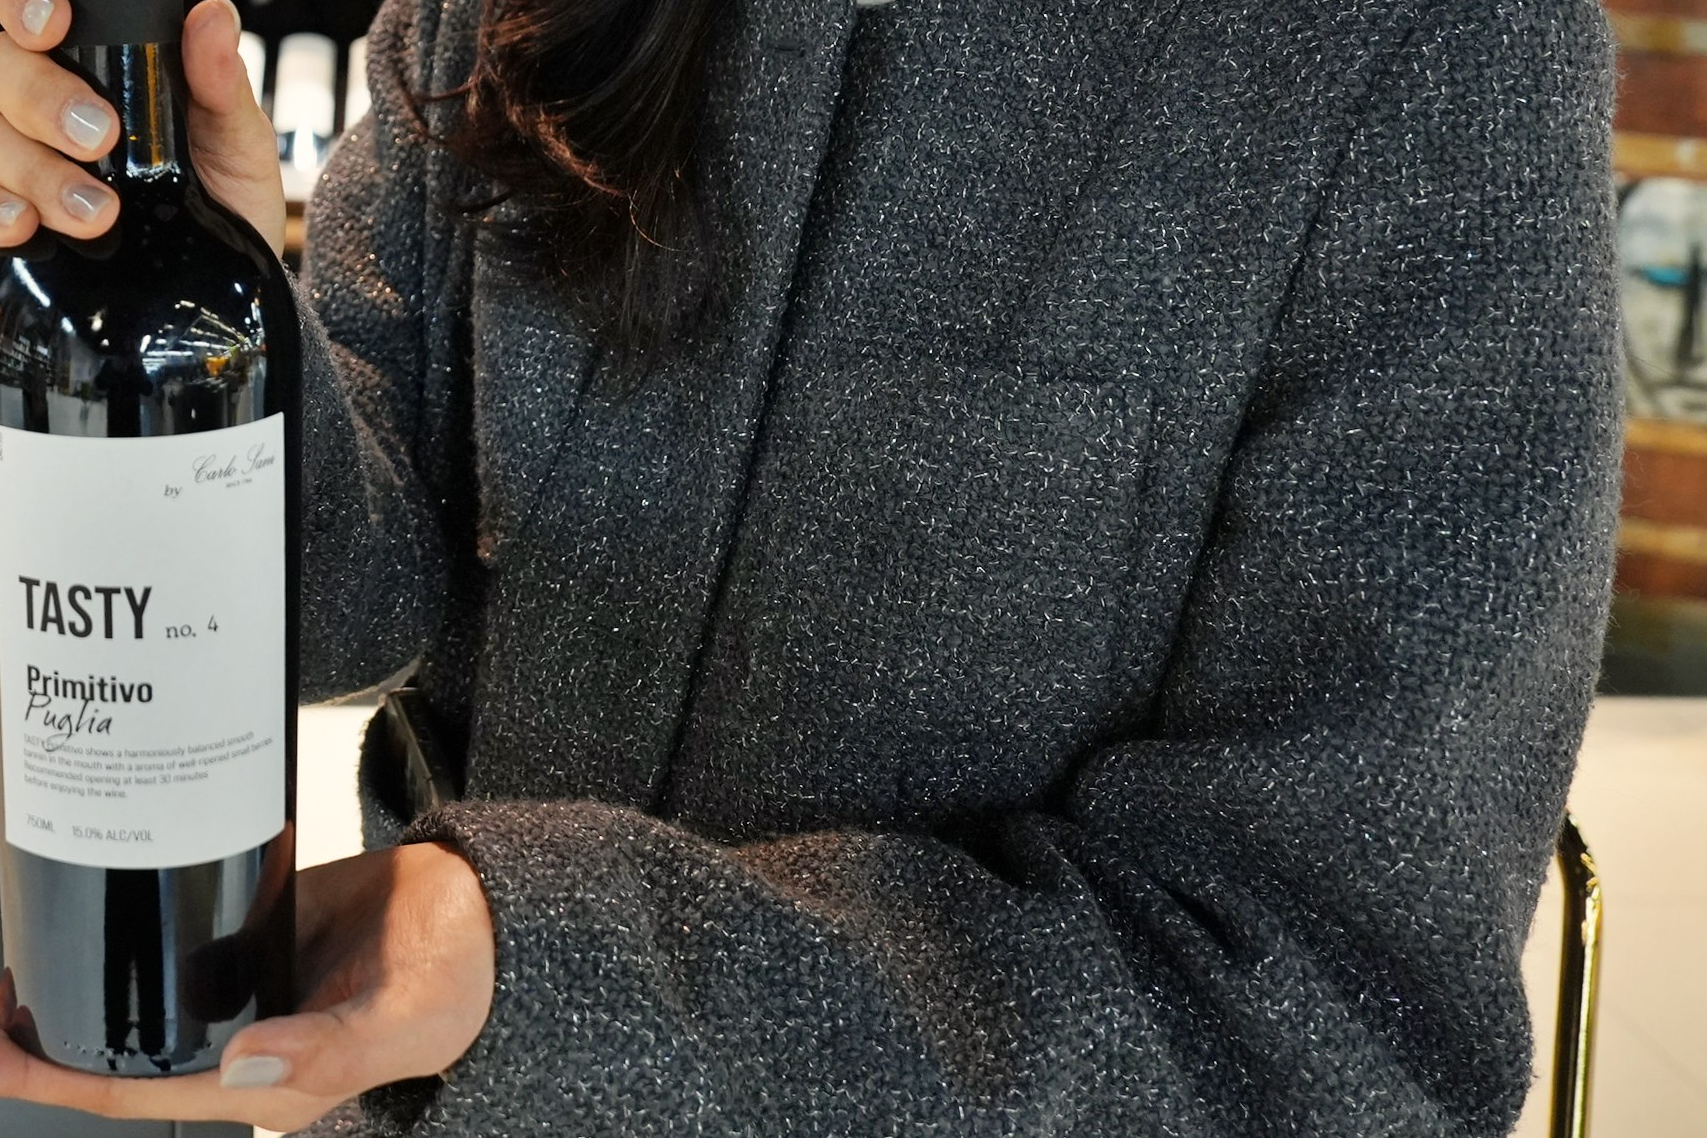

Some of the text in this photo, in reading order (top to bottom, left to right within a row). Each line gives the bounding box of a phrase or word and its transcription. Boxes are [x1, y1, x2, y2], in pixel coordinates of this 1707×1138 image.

[164, 484, 182, 499] by
[18, 575, 219, 639] TASTY no. 4
[27, 663, 153, 704] Primitivo
[24, 689, 113, 752] Puglia
[86, 747, 114, 758] shows
[73, 758, 103, 770] mouth
[105, 760, 125, 771] with
[84, 773, 121, 787] opening
[159, 773, 171, 784] 30
[87, 787, 102, 797] the
[105, 828, 153, 842] ALC/VOL
